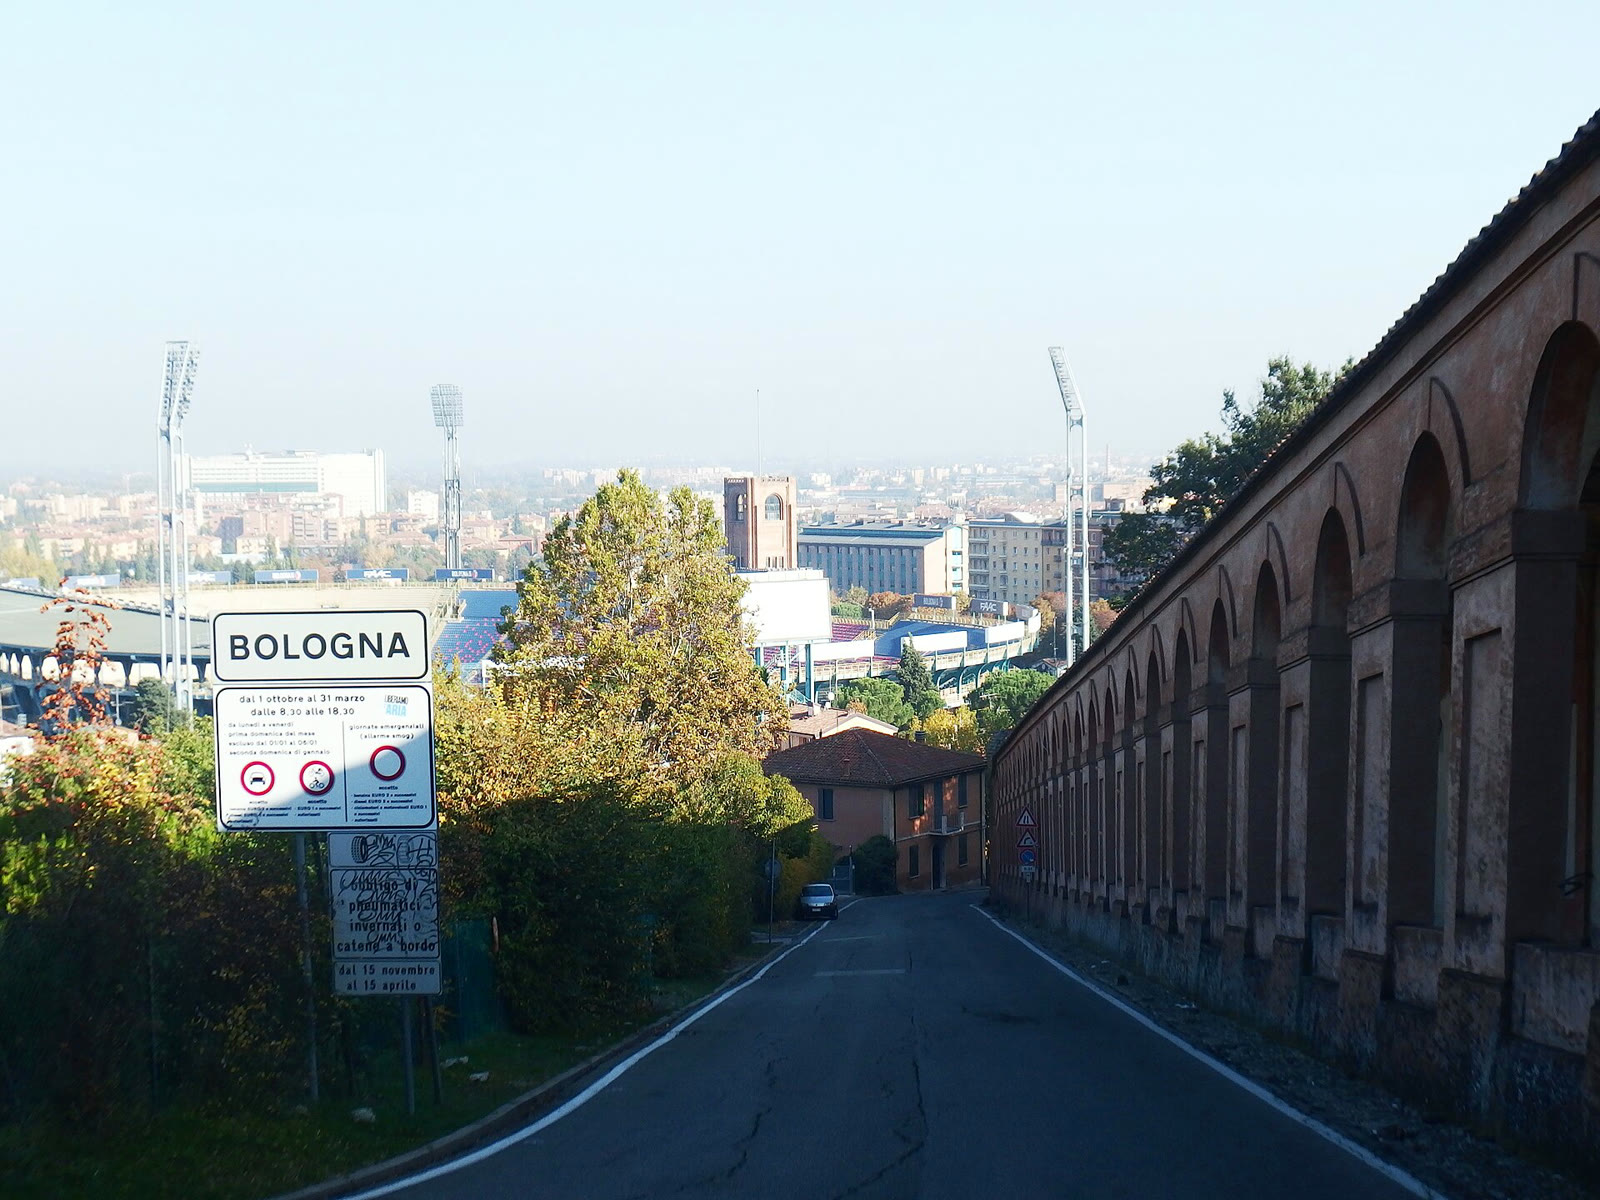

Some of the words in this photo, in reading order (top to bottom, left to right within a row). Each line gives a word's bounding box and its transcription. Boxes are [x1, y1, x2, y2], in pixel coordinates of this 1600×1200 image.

[229, 632, 410, 660] BOLOGNA
[239, 695, 255, 703] dal
[266, 695, 304, 703] ottobre
[307, 695, 317, 703] al
[320, 694, 331, 702] 31
[250, 708, 276, 716] dalle
[305, 707, 324, 715] alle
[349, 900, 421, 914] pneumatici
[414, 922, 421, 932] o
[337, 941, 380, 952] catene
[386, 942, 393, 952] a
[401, 939, 436, 951] bordo
[339, 965, 356, 976] dal
[363, 964, 375, 975] 15
[382, 964, 435, 975] novembre
[347, 981, 357, 991] al
[364, 980, 376, 990] 15
[382, 981, 417, 993] aprile
